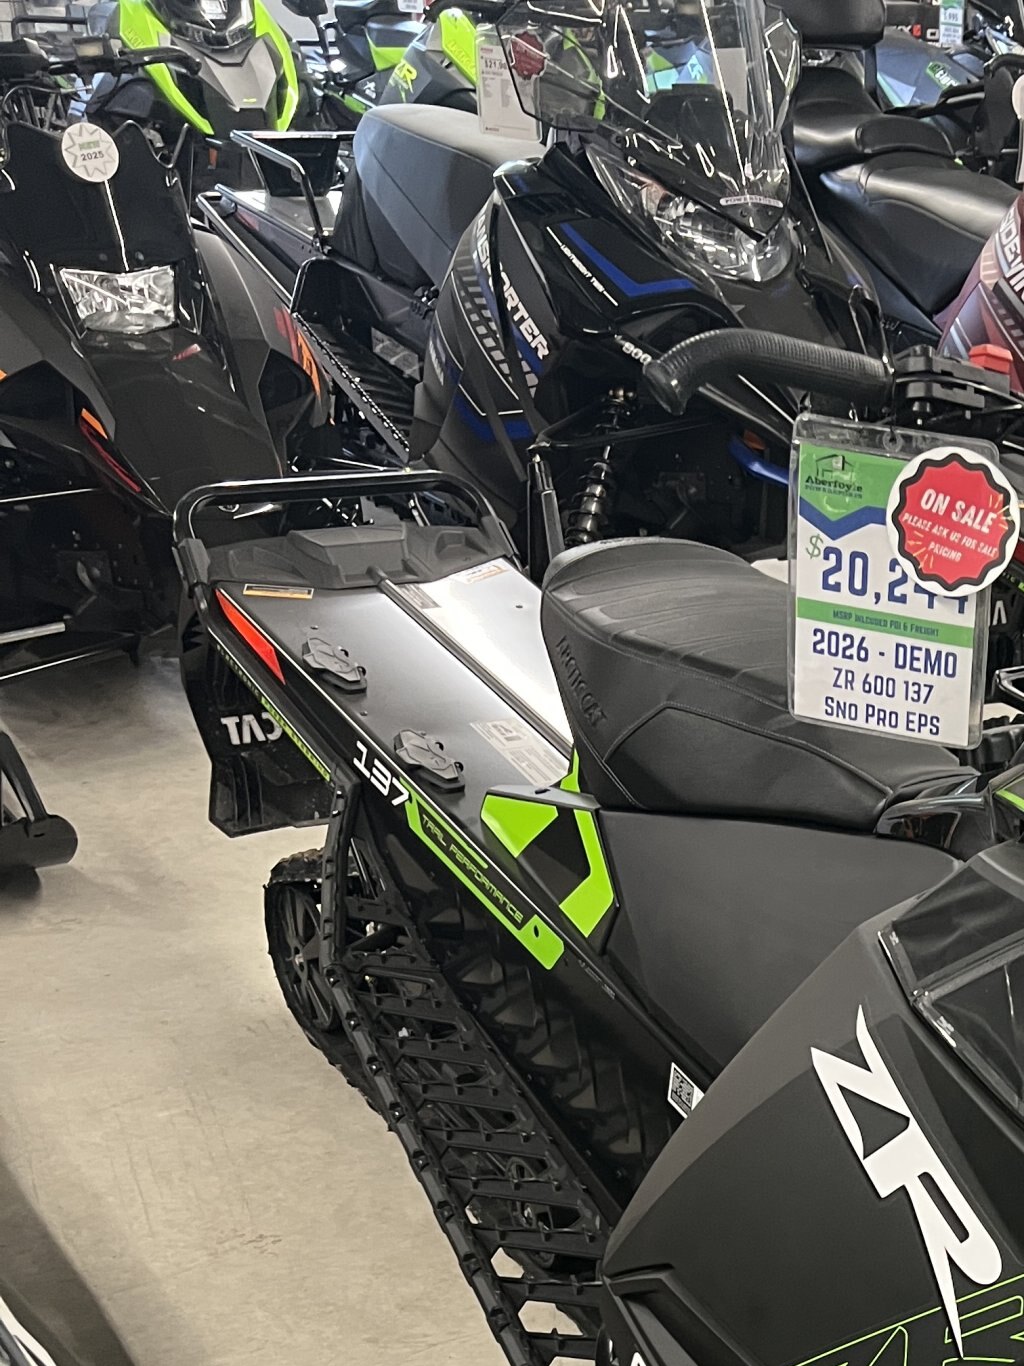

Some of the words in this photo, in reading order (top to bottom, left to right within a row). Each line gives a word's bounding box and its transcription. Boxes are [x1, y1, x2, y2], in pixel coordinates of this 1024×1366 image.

[81, 150, 105, 161] 2025
[920, 488, 950, 515] ON
[952, 501, 998, 534] SALE
[903, 513, 931, 531] PLEASE
[932, 524, 947, 537] ASK
[949, 530, 960, 542] US
[962, 535, 976, 549] FOR
[977, 540, 998, 557] SALE
[929, 542, 962, 562] PRICING
[833, 610, 852, 620] MSRP
[889, 620, 901, 630] PDI
[910, 624, 939, 637] FREIGHT
[812, 628, 869, 663] 2026
[894, 642, 957, 678] DEMO
[555, 634, 588, 694] ARCTIC
[580, 691, 608, 726] CAT
[832, 667, 855, 691] ZR
[862, 673, 896, 698] 600
[903, 680, 934, 705] 137
[824, 696, 858, 721] SNO
[865, 703, 898, 728] PRO
[905, 711, 940, 736] EPS
[353, 740, 410, 806] 137
[422, 813, 447, 847] TRAIL
[450, 843, 524, 924] PERFORMANCE
[811, 1003, 1003, 1361] ZR
